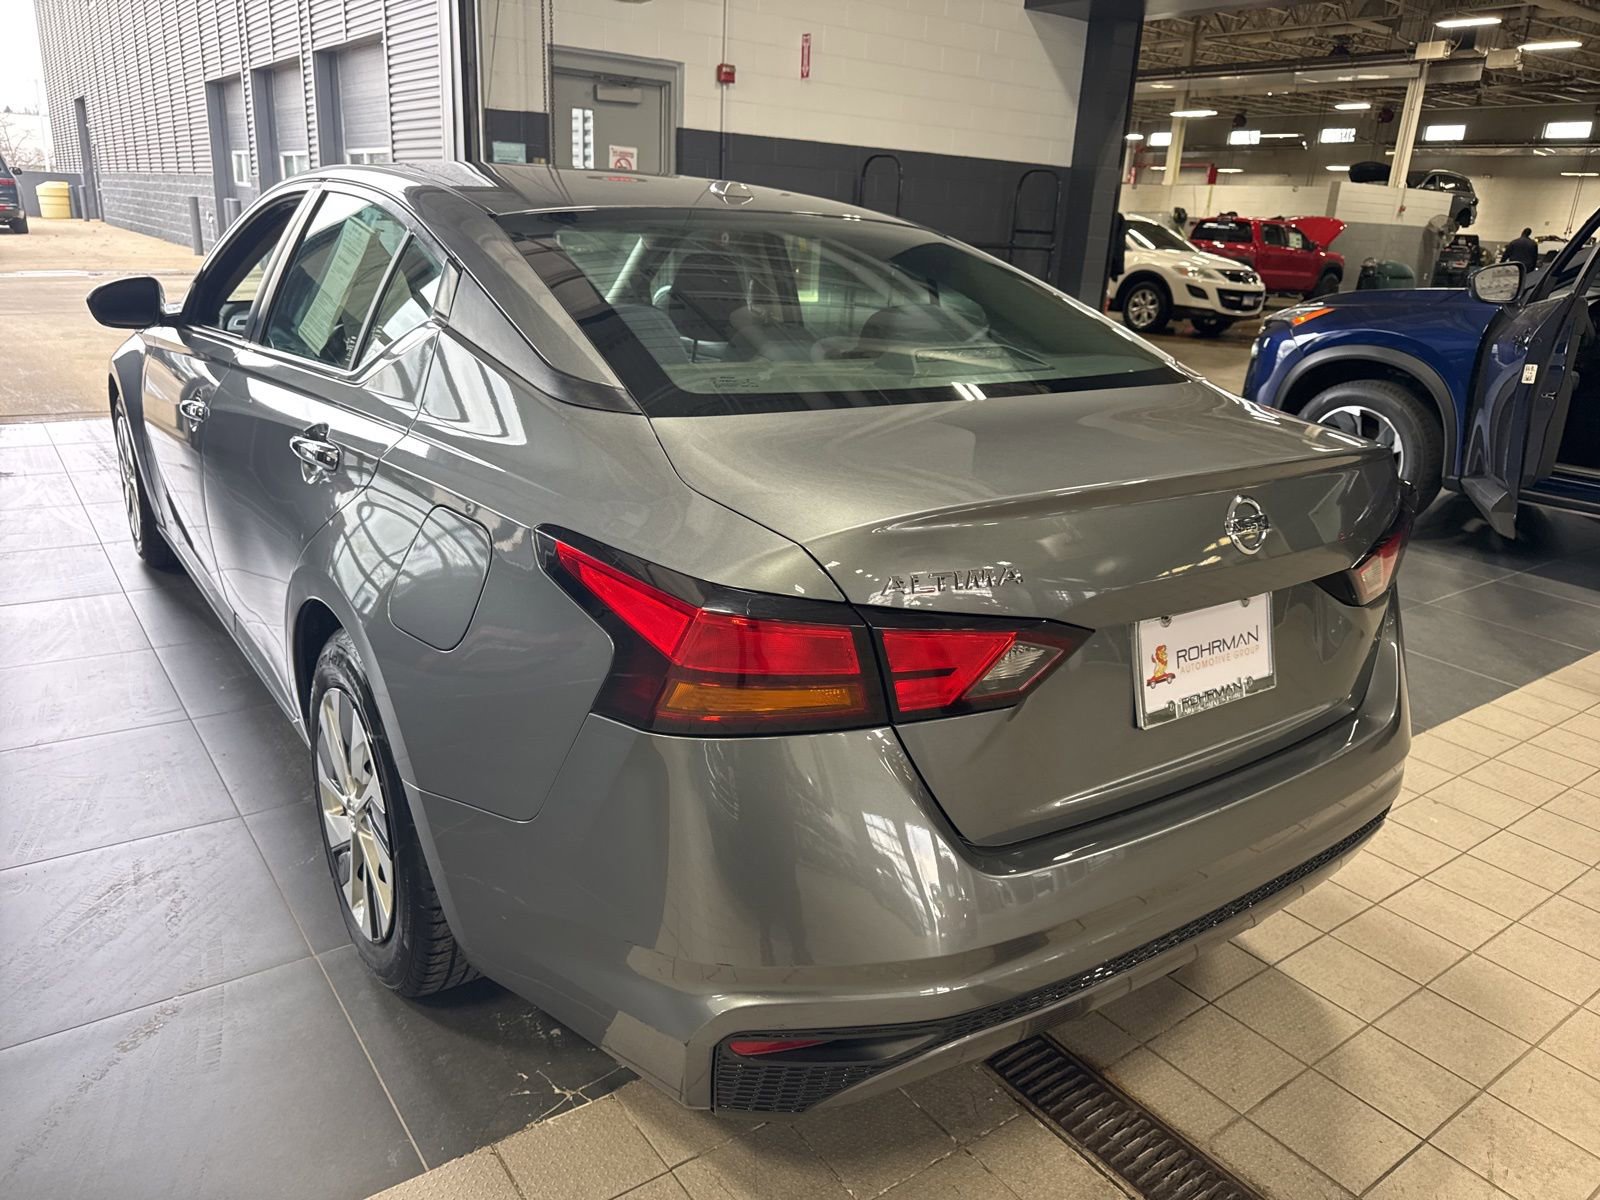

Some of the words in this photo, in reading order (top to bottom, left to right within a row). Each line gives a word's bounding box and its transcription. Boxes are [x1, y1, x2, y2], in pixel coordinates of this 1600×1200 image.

[881, 567, 1024, 596] ALTIMA
[1176, 625, 1259, 669] ROHRMAN
[1181, 653, 1231, 673] AUTOMOTIVE
[1233, 645, 1259, 660] GROUP
[1181, 677, 1242, 712] ROHRMAN
